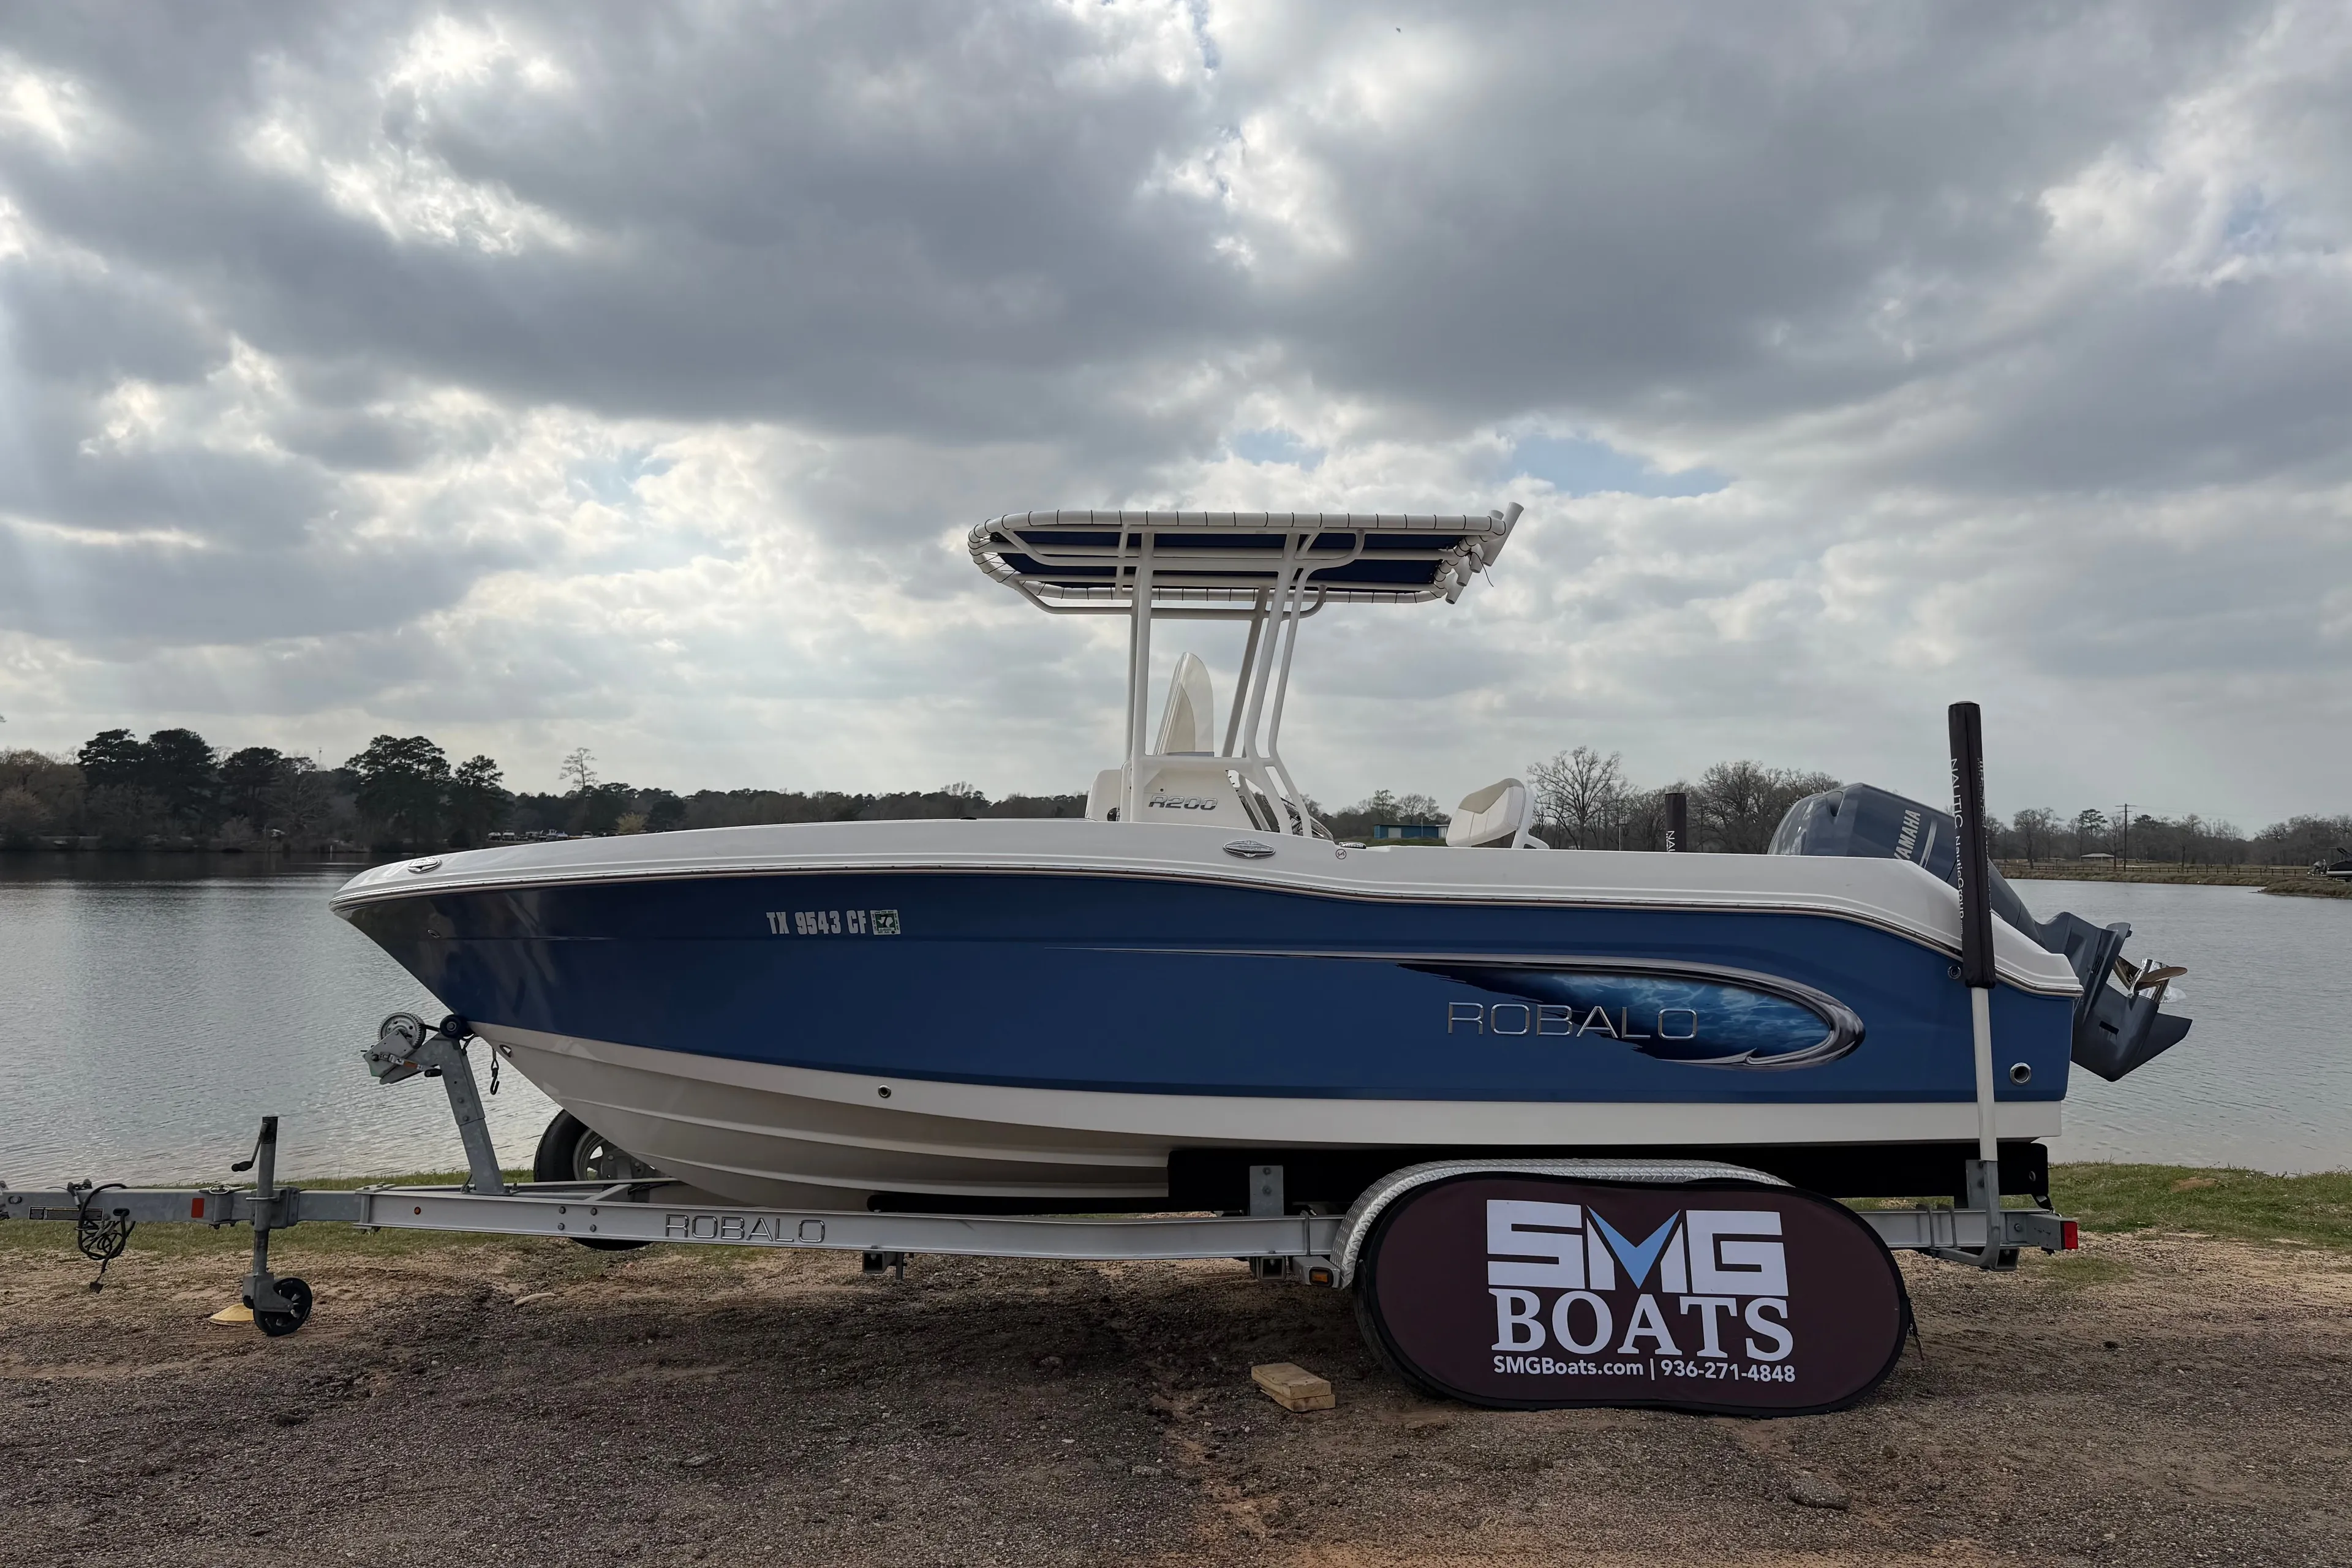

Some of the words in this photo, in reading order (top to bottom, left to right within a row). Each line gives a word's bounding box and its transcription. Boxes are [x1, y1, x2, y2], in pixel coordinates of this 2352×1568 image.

[1148, 794, 1218, 811] R200
[1951, 758, 1963, 828] NAUTIC
[766, 912, 790, 934] TX
[794, 910, 842, 935] 9543
[846, 910, 867, 934] CF
[1447, 1001, 1698, 1041] ROBALO
[665, 1214, 826, 1243] ROBALO
[1487, 1199, 1789, 1297] SMG
[1488, 1287, 1794, 1362] BOATS
[1493, 1355, 1644, 1376] SMGBoats.com
[1660, 1359, 1796, 1383] 936-271-4848
